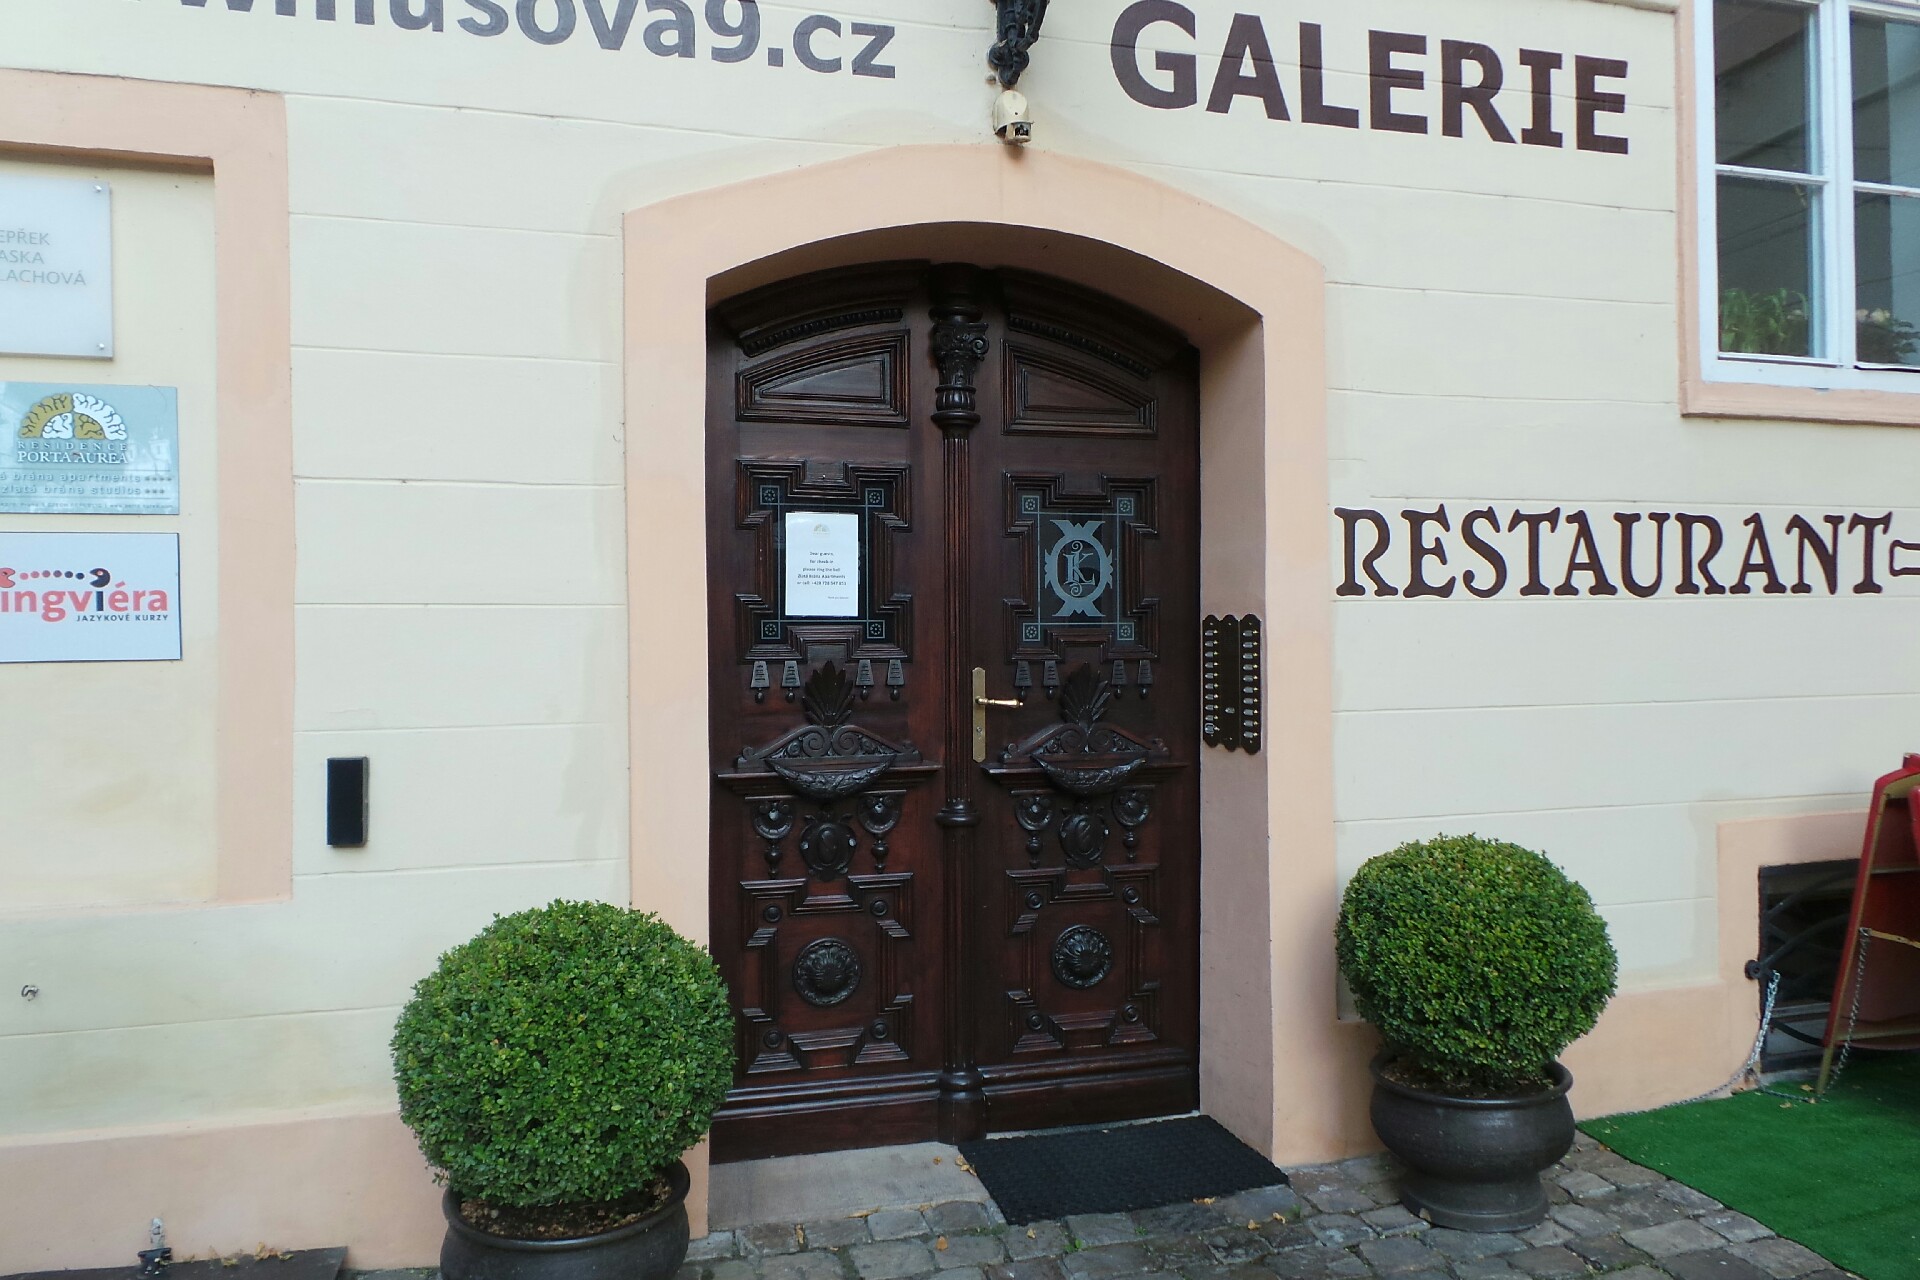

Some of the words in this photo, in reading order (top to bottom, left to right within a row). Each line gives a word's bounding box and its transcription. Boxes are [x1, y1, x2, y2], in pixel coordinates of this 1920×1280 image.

[1110, 0, 1629, 155] GALERIE
[18, 441, 128, 451] RESIDENCE
[17, 451, 72, 464] PORTA
[73, 452, 129, 465] AUREA
[60, 474, 142, 484] apartments
[91, 486, 142, 496] studios
[1333, 503, 1893, 599] RESTAURANT
[76, 613, 131, 622] JAZYKOVÉ
